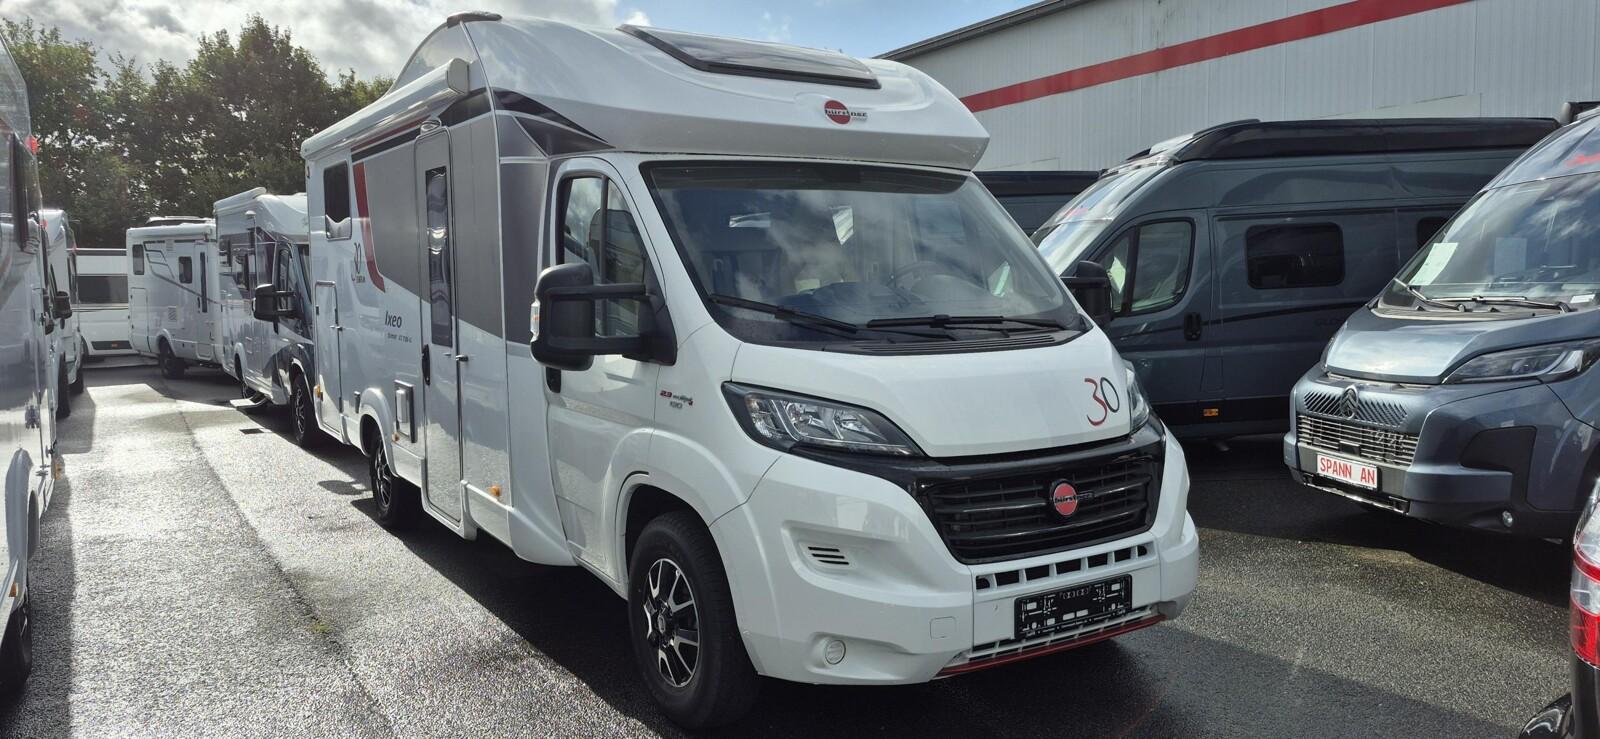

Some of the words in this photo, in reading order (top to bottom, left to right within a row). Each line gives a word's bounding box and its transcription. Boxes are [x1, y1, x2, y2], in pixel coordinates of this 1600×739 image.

[385, 311, 403, 328] Ixeo
[1084, 377, 1120, 426] 30
[1320, 457, 1352, 479] SPANN
[1360, 467, 1375, 485] AN
